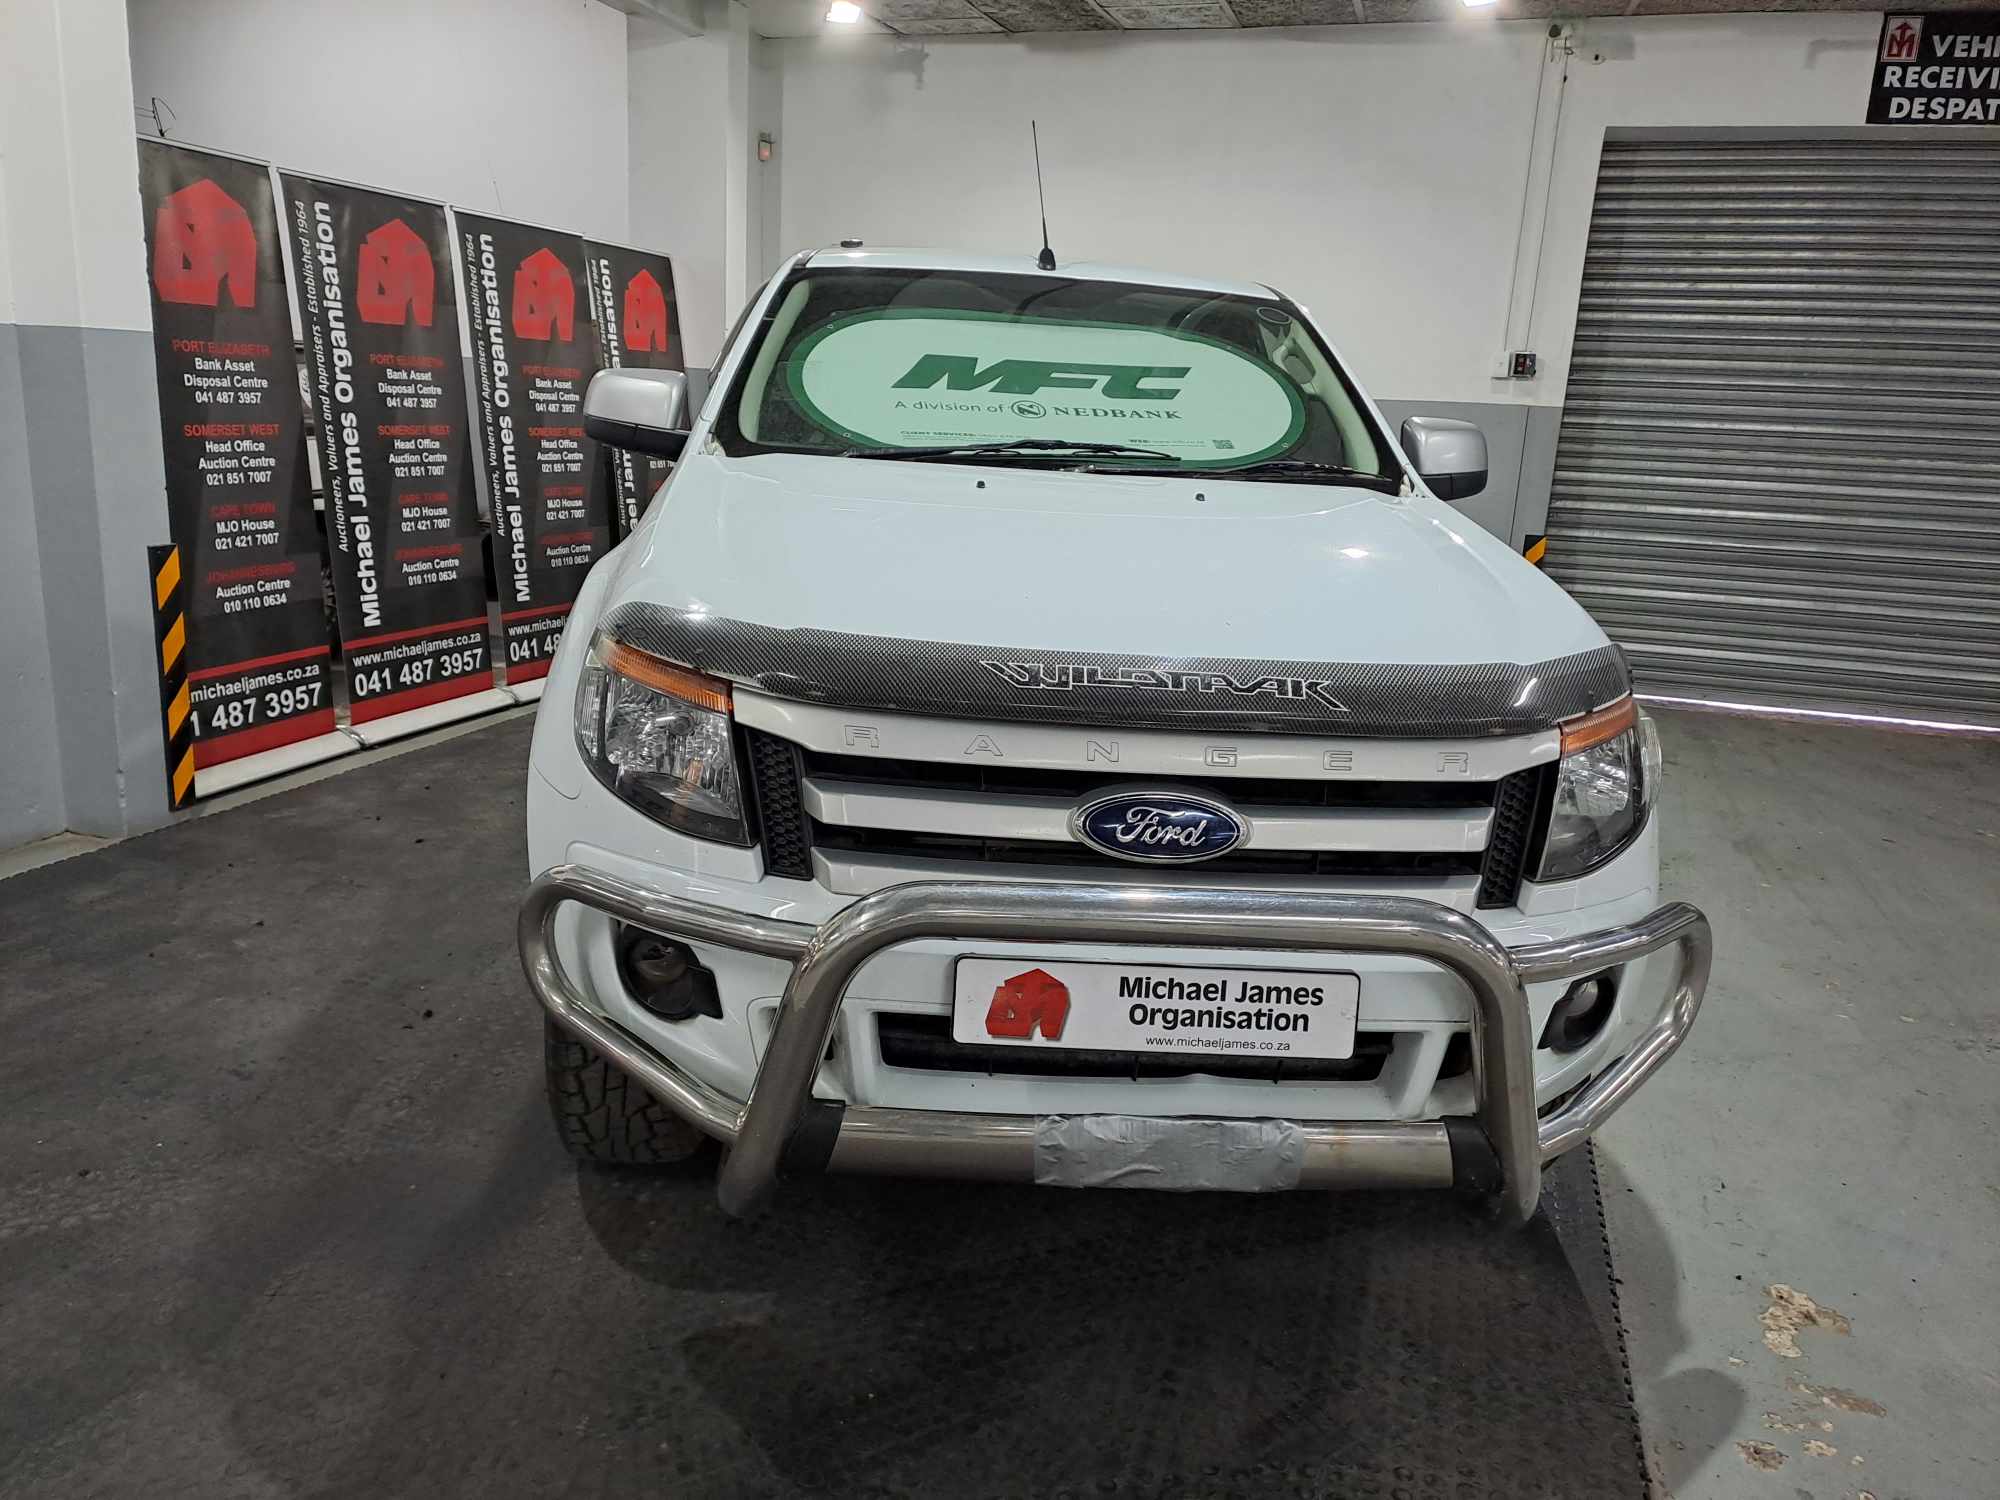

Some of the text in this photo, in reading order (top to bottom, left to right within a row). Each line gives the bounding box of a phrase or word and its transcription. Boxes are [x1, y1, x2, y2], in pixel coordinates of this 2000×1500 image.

[1932, 35, 2000, 57] VEHI
[1883, 66, 2000, 89] RECEIVI
[1888, 97, 2000, 120] DESPAT
[294, 200, 309, 233] 1964
[465, 233, 476, 262] 1964
[299, 237, 319, 313] Established
[467, 265, 482, 330] Established
[171, 339, 204, 352] PORT
[194, 357, 255, 371] Bank Asset
[312, 324, 330, 394] Appraisers
[477, 339, 492, 400] Appraisers
[183, 373, 268, 389] Disposal Centre
[386, 369, 432, 381] Bank Asset
[891, 354, 1192, 399] MFC
[195, 391, 262, 404] 041 487 3957
[378, 382, 442, 395] Disposal Centre
[320, 395, 332, 421] and
[386, 397, 401, 408] 041
[403, 398, 418, 408] 487
[482, 400, 493, 423] and
[895, 400, 1183, 419] A division of NEDBANK
[314, 201, 382, 628] Michael James Organisation
[480, 233, 530, 602] Michael James Organisation
[184, 423, 280, 437] SOMERSET WEST
[205, 439, 266, 453] Head Office
[325, 424, 338, 471] Valuers
[394, 438, 440, 450] Head Office
[487, 425, 498, 467] Valuers
[558, 439, 578, 449] Office
[198, 455, 276, 470] Auction Centre
[388, 452, 448, 464] Auction Centre
[206, 470, 272, 486] 021 851 7007
[394, 466, 445, 477] 021 851 7007
[331, 475, 349, 552] Auctioneers,
[402, 506, 448, 518] MJO House
[546, 511, 557, 521] 021
[216, 519, 275, 534] MJO House
[401, 518, 451, 532] 021 421 7007
[215, 532, 279, 550] 021 421 7007
[402, 558, 460, 573] Auction Centre
[216, 579, 291, 599] Auction Centre
[408, 575, 422, 586] 010
[424, 573, 437, 583] 110
[224, 593, 287, 613] 010 110 0634
[352, 632, 481, 667] www.michaeljames.co.za
[509, 637, 538, 661] 041
[190, 664, 320, 703] michaeljames.co.za
[354, 648, 483, 697] 041 487 3957
[979, 661, 1350, 711] WILDTRAK
[211, 697, 257, 730] 487
[264, 681, 322, 718] 3957
[845, 725, 1469, 773] RANGER
[1115, 806, 1207, 850] Ford
[1119, 976, 1324, 1006] Michael James
[1129, 1003, 1309, 1032] Organisation
[1145, 1036, 1290, 1051] www.michaeljames.co.za
